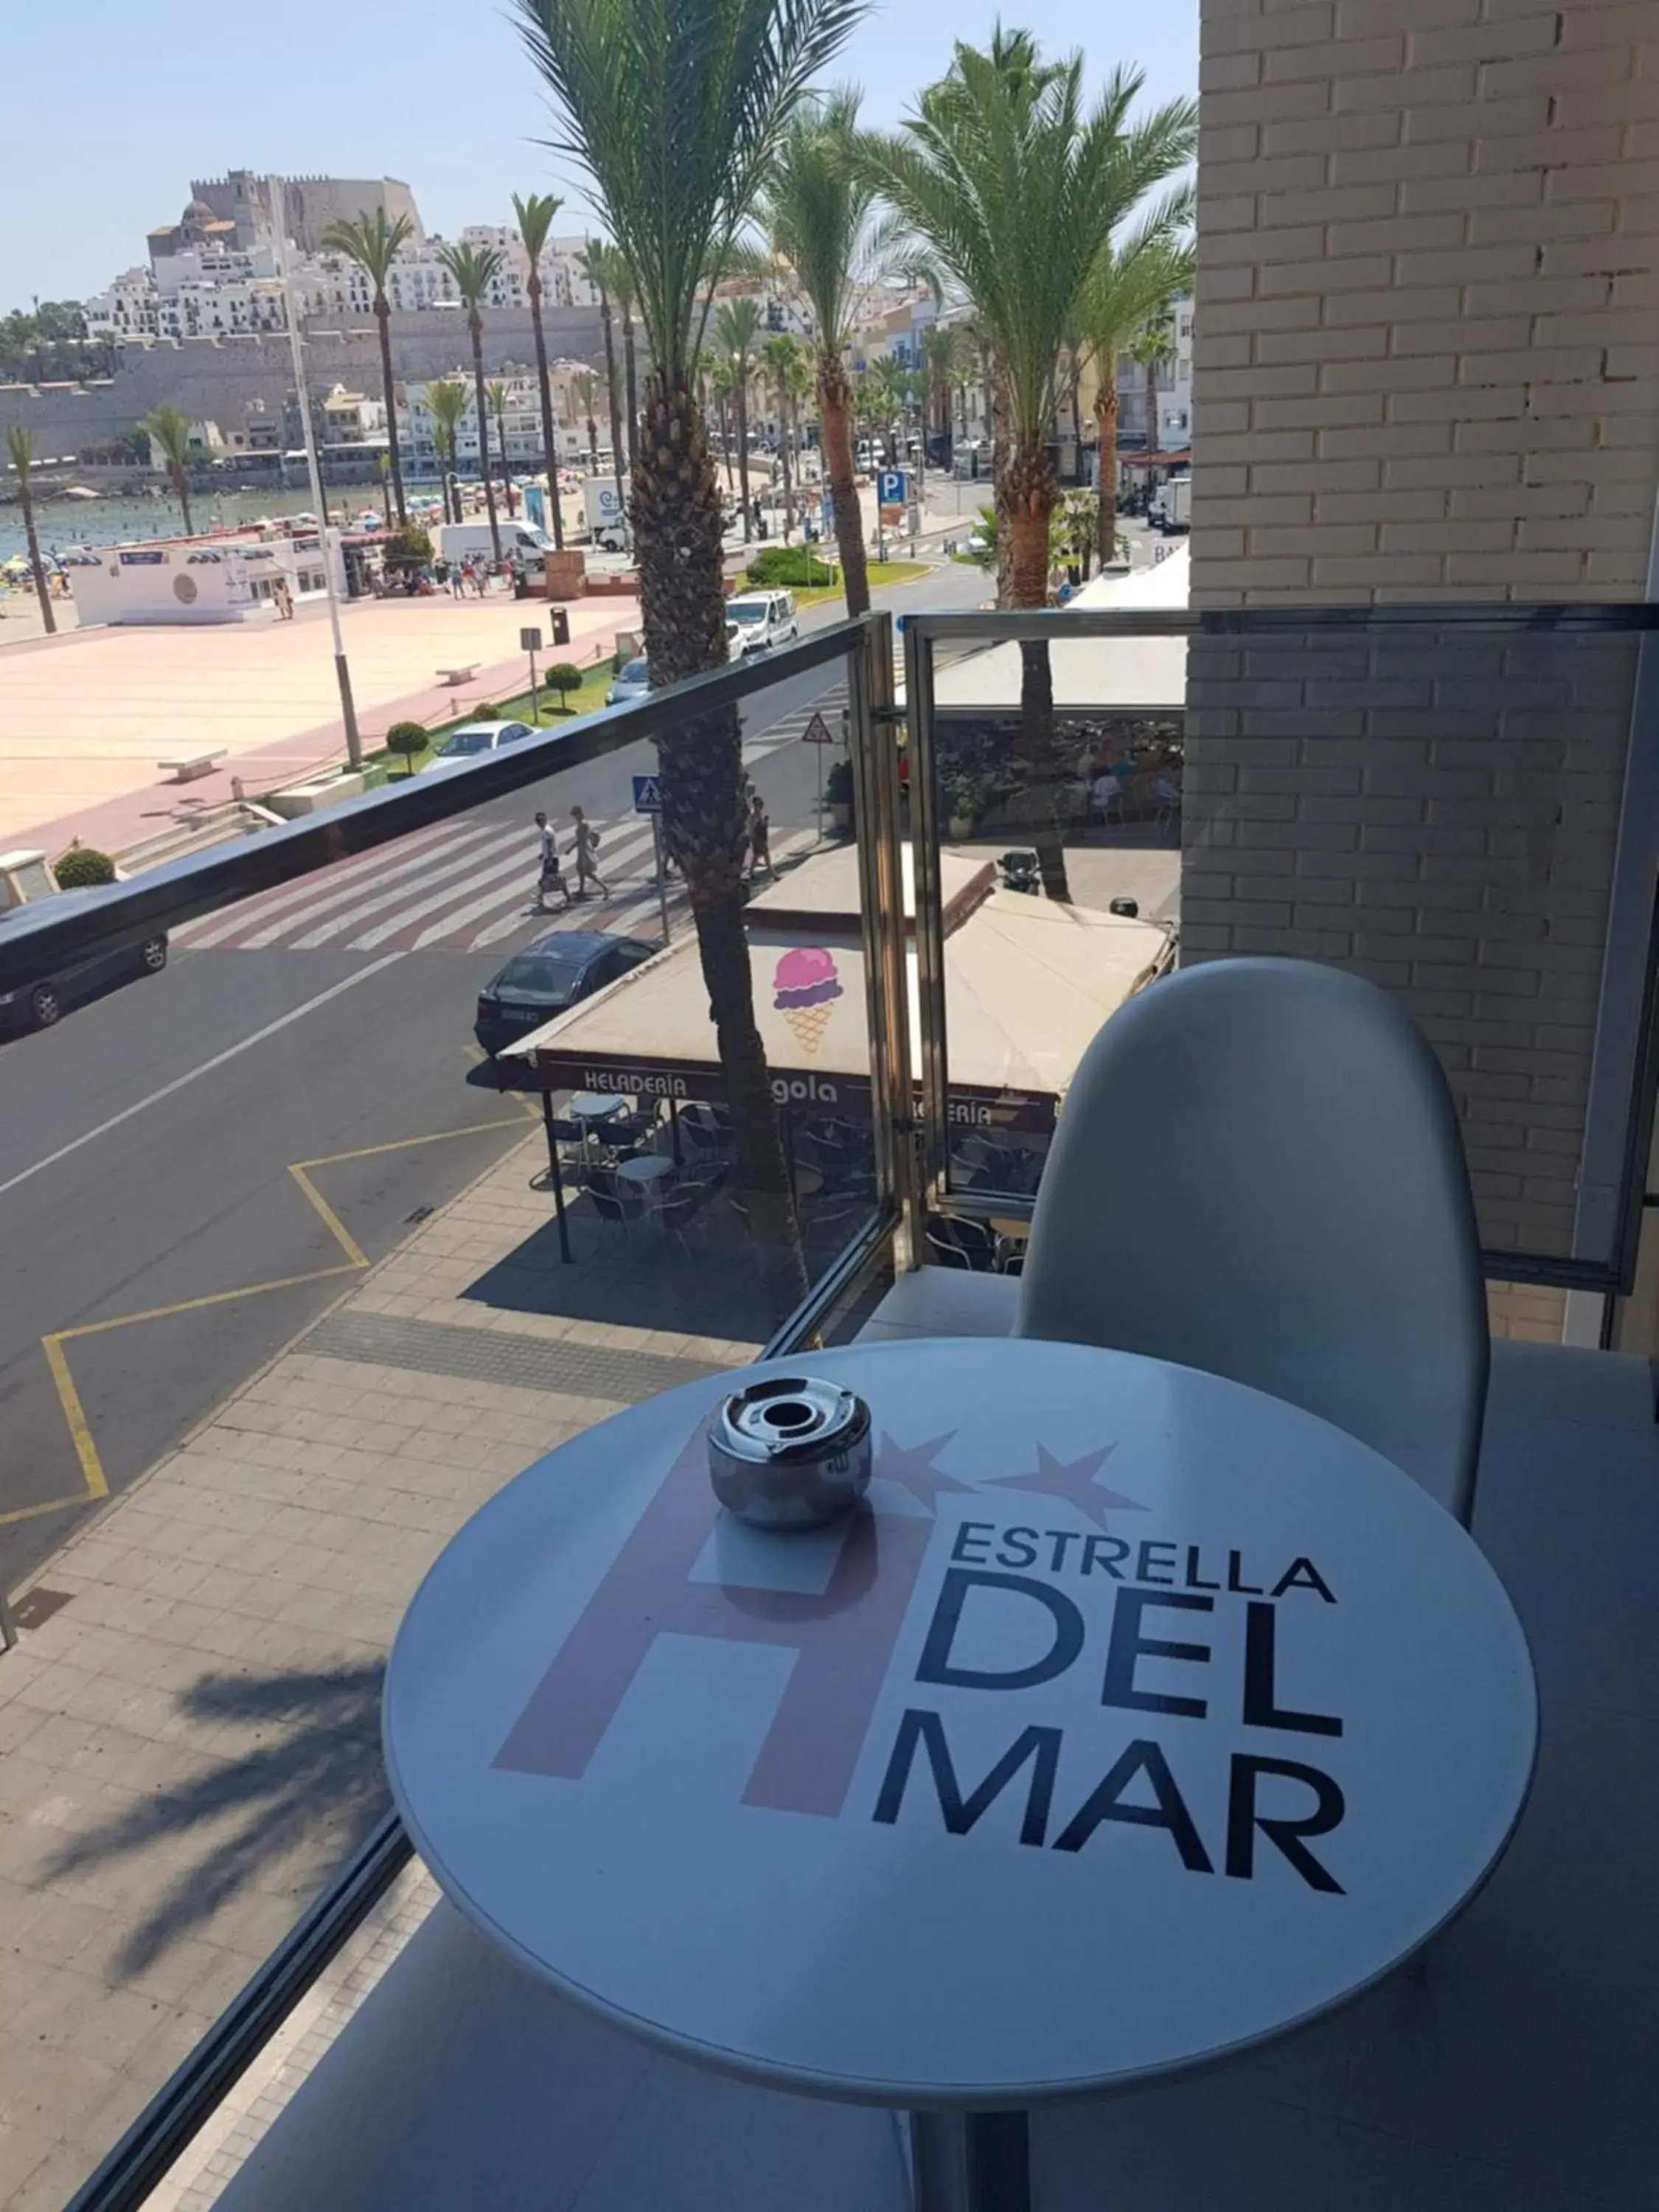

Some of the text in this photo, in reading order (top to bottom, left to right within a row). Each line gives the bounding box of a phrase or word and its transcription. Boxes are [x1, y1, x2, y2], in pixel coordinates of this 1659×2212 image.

[884, 474, 898, 498] P
[585, 1071, 686, 1096] HELADERÍA
[771, 1075, 838, 1104] gola
[950, 1522, 1338, 1603] ESTRELLA
[914, 1568, 1343, 1738] DEL
[872, 1708, 1347, 1896] MAR
